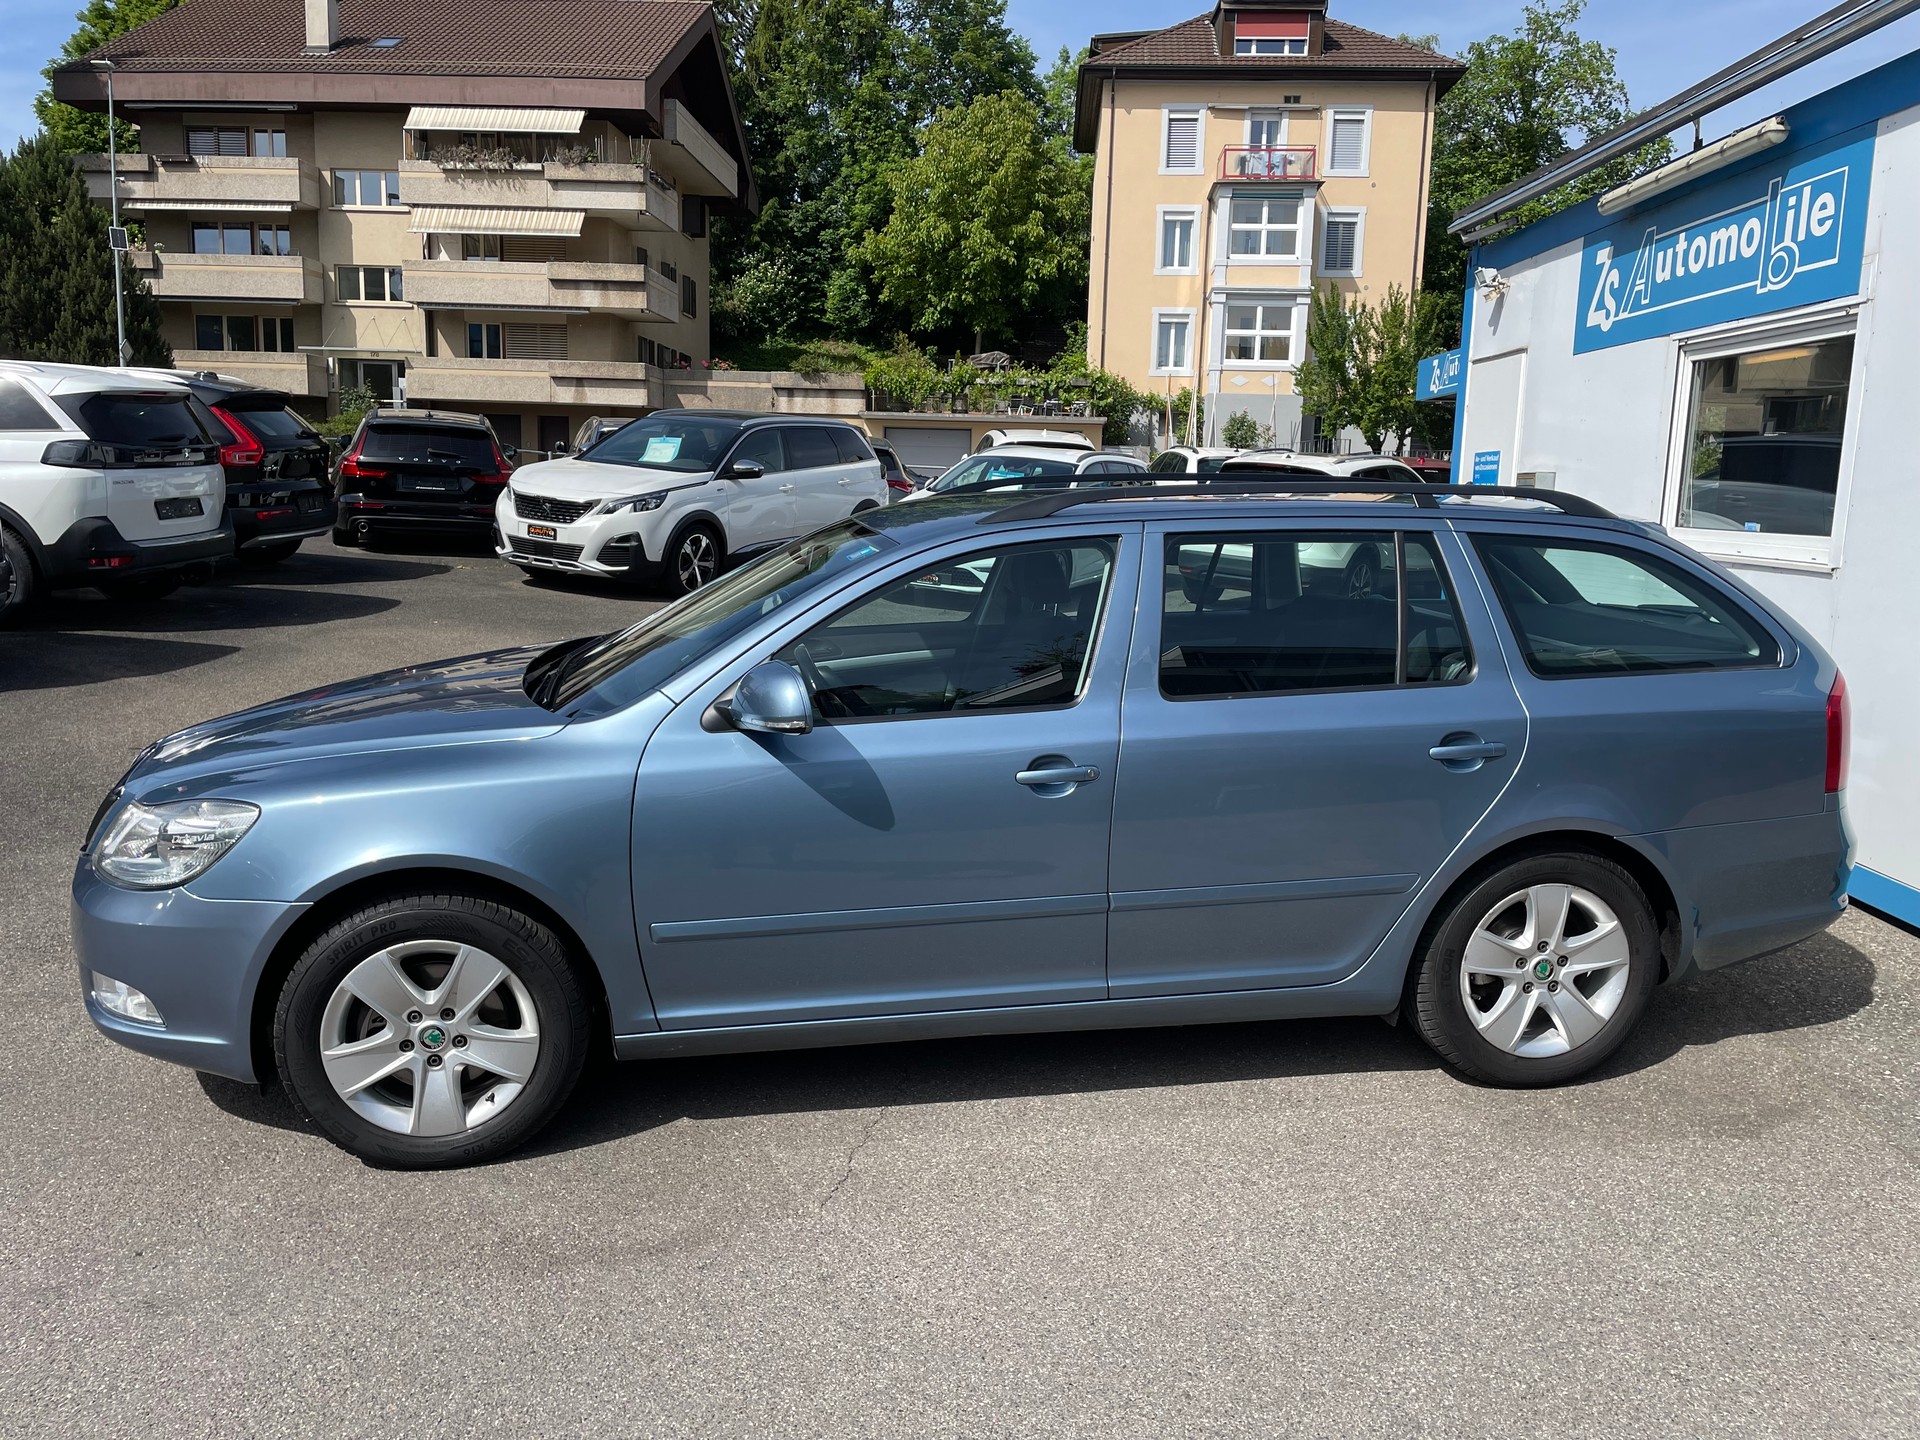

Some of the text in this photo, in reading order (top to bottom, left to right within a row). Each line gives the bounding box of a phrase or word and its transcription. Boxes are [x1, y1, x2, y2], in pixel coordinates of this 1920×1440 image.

[1618, 177, 1837, 316] Automobile
[1440, 353, 1460, 387] Aut
[398, 456, 461, 464] VOLVO
[171, 833, 215, 845] Octavia
[326, 920, 397, 965] SPIRIT PRO
